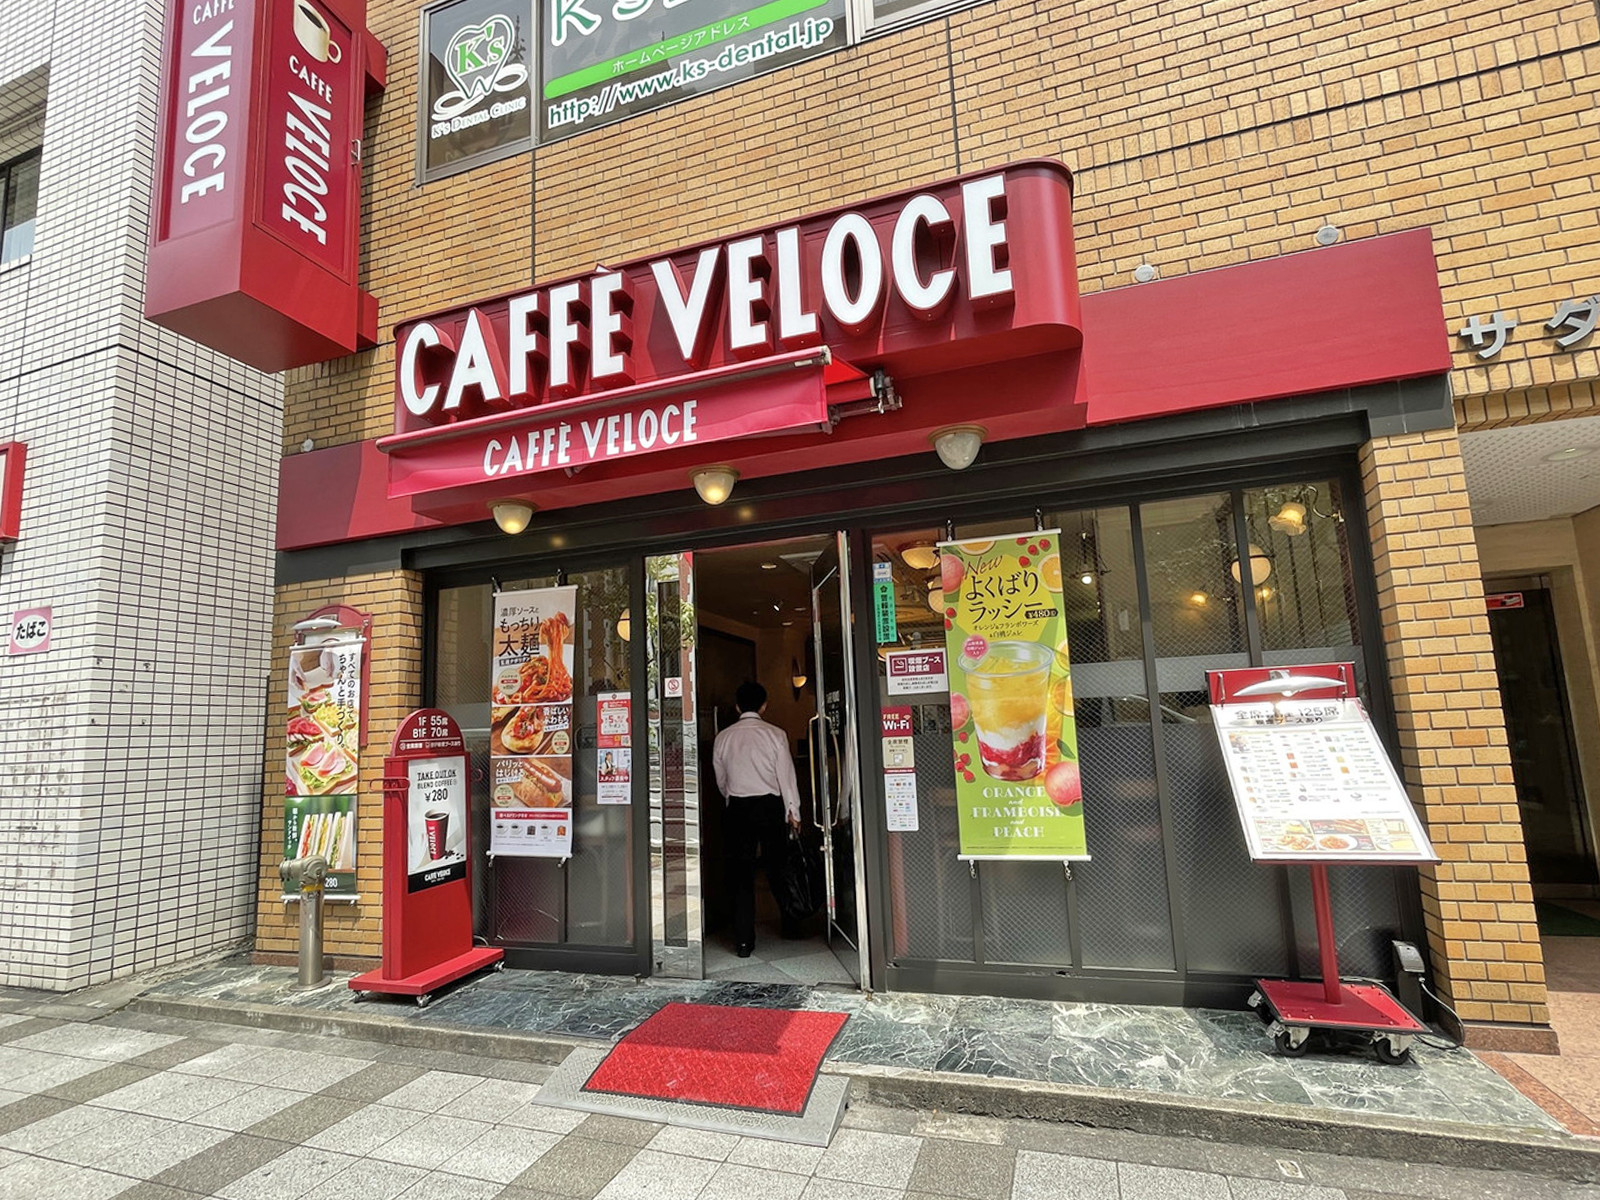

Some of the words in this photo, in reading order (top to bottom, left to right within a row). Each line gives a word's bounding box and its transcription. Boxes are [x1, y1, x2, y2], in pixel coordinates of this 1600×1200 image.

[612, 15, 750, 74] ホームページアドレス
[548, 17, 834, 128] http://www.ks-dental.jp
[181, 19, 233, 204] VELOCE
[282, 91, 332, 246] VELOCE
[401, 263, 624, 415] CAFFÈ
[650, 174, 1014, 360] VELOCE
[483, 422, 571, 476] CAFFÈ
[580, 400, 697, 459] VELOCE
[965, 555, 1003, 580] New
[965, 570, 1039, 600] よくばり
[969, 599, 1043, 624] ラッシー
[15, 621, 46, 639] たばこ
[500, 616, 540, 633] もっちり
[499, 633, 540, 657] 太麺
[418, 716, 427, 726] 1F
[417, 771, 433, 780] TAKE
[435, 769, 447, 778] OUT
[425, 788, 448, 801] ¥280
[983, 786, 1045, 798] ORANGE
[993, 826, 1045, 838] PEACH
